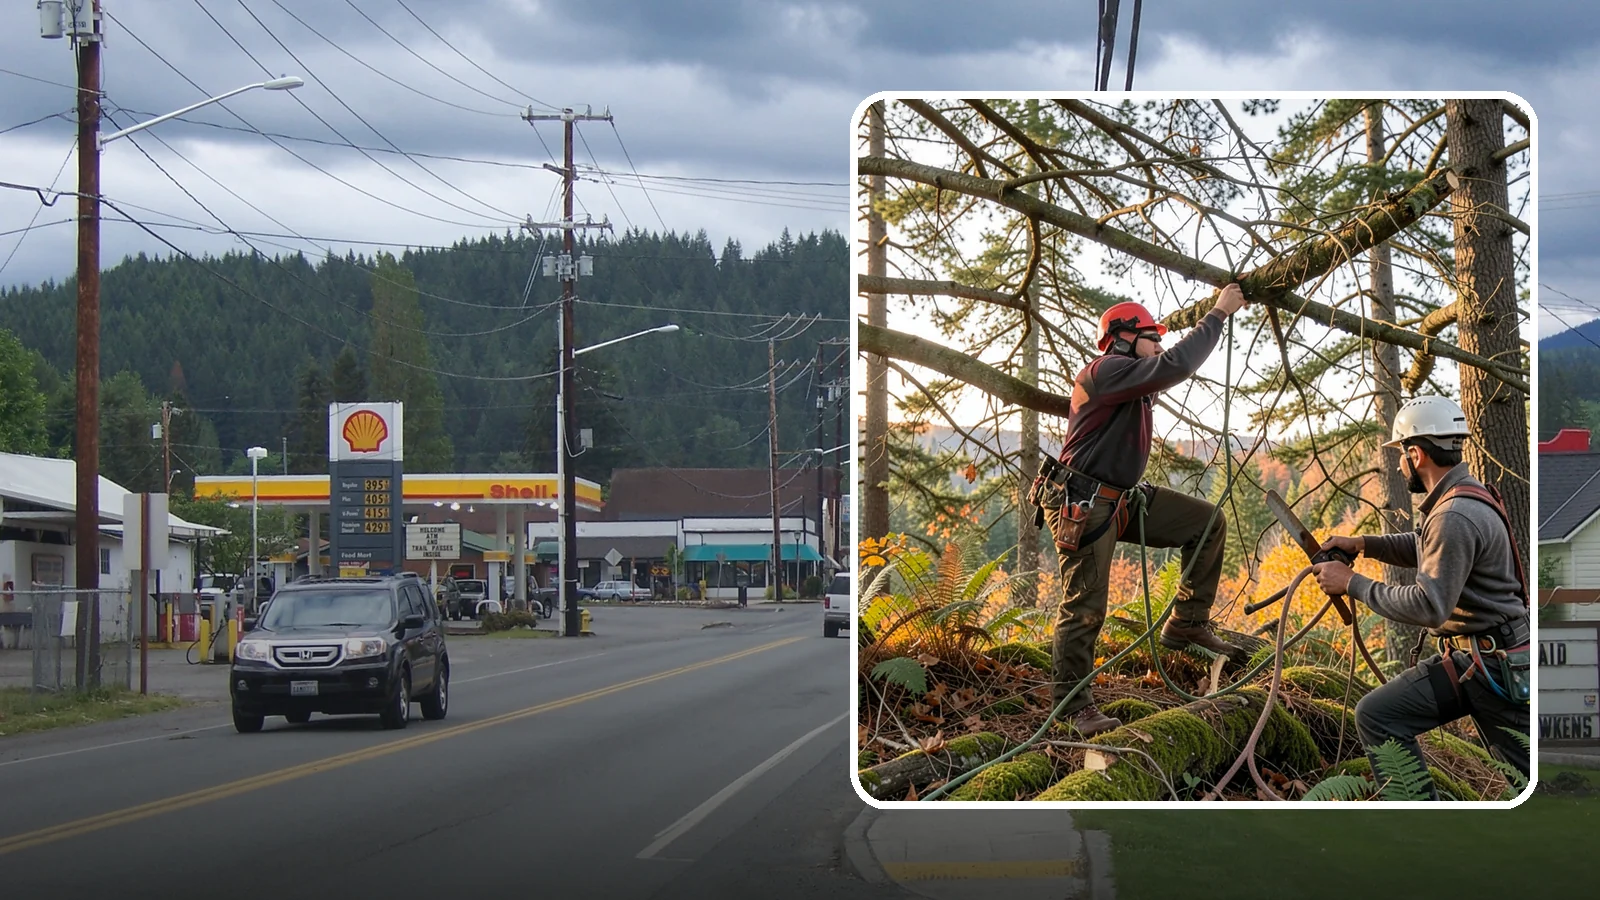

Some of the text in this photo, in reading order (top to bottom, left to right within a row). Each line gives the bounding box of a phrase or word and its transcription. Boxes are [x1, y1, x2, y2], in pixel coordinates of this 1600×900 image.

[365, 480, 383, 490] 395
[490, 484, 547, 499] Shell
[365, 494, 383, 504] 405
[365, 508, 383, 518] 415
[365, 522, 383, 533] 429
